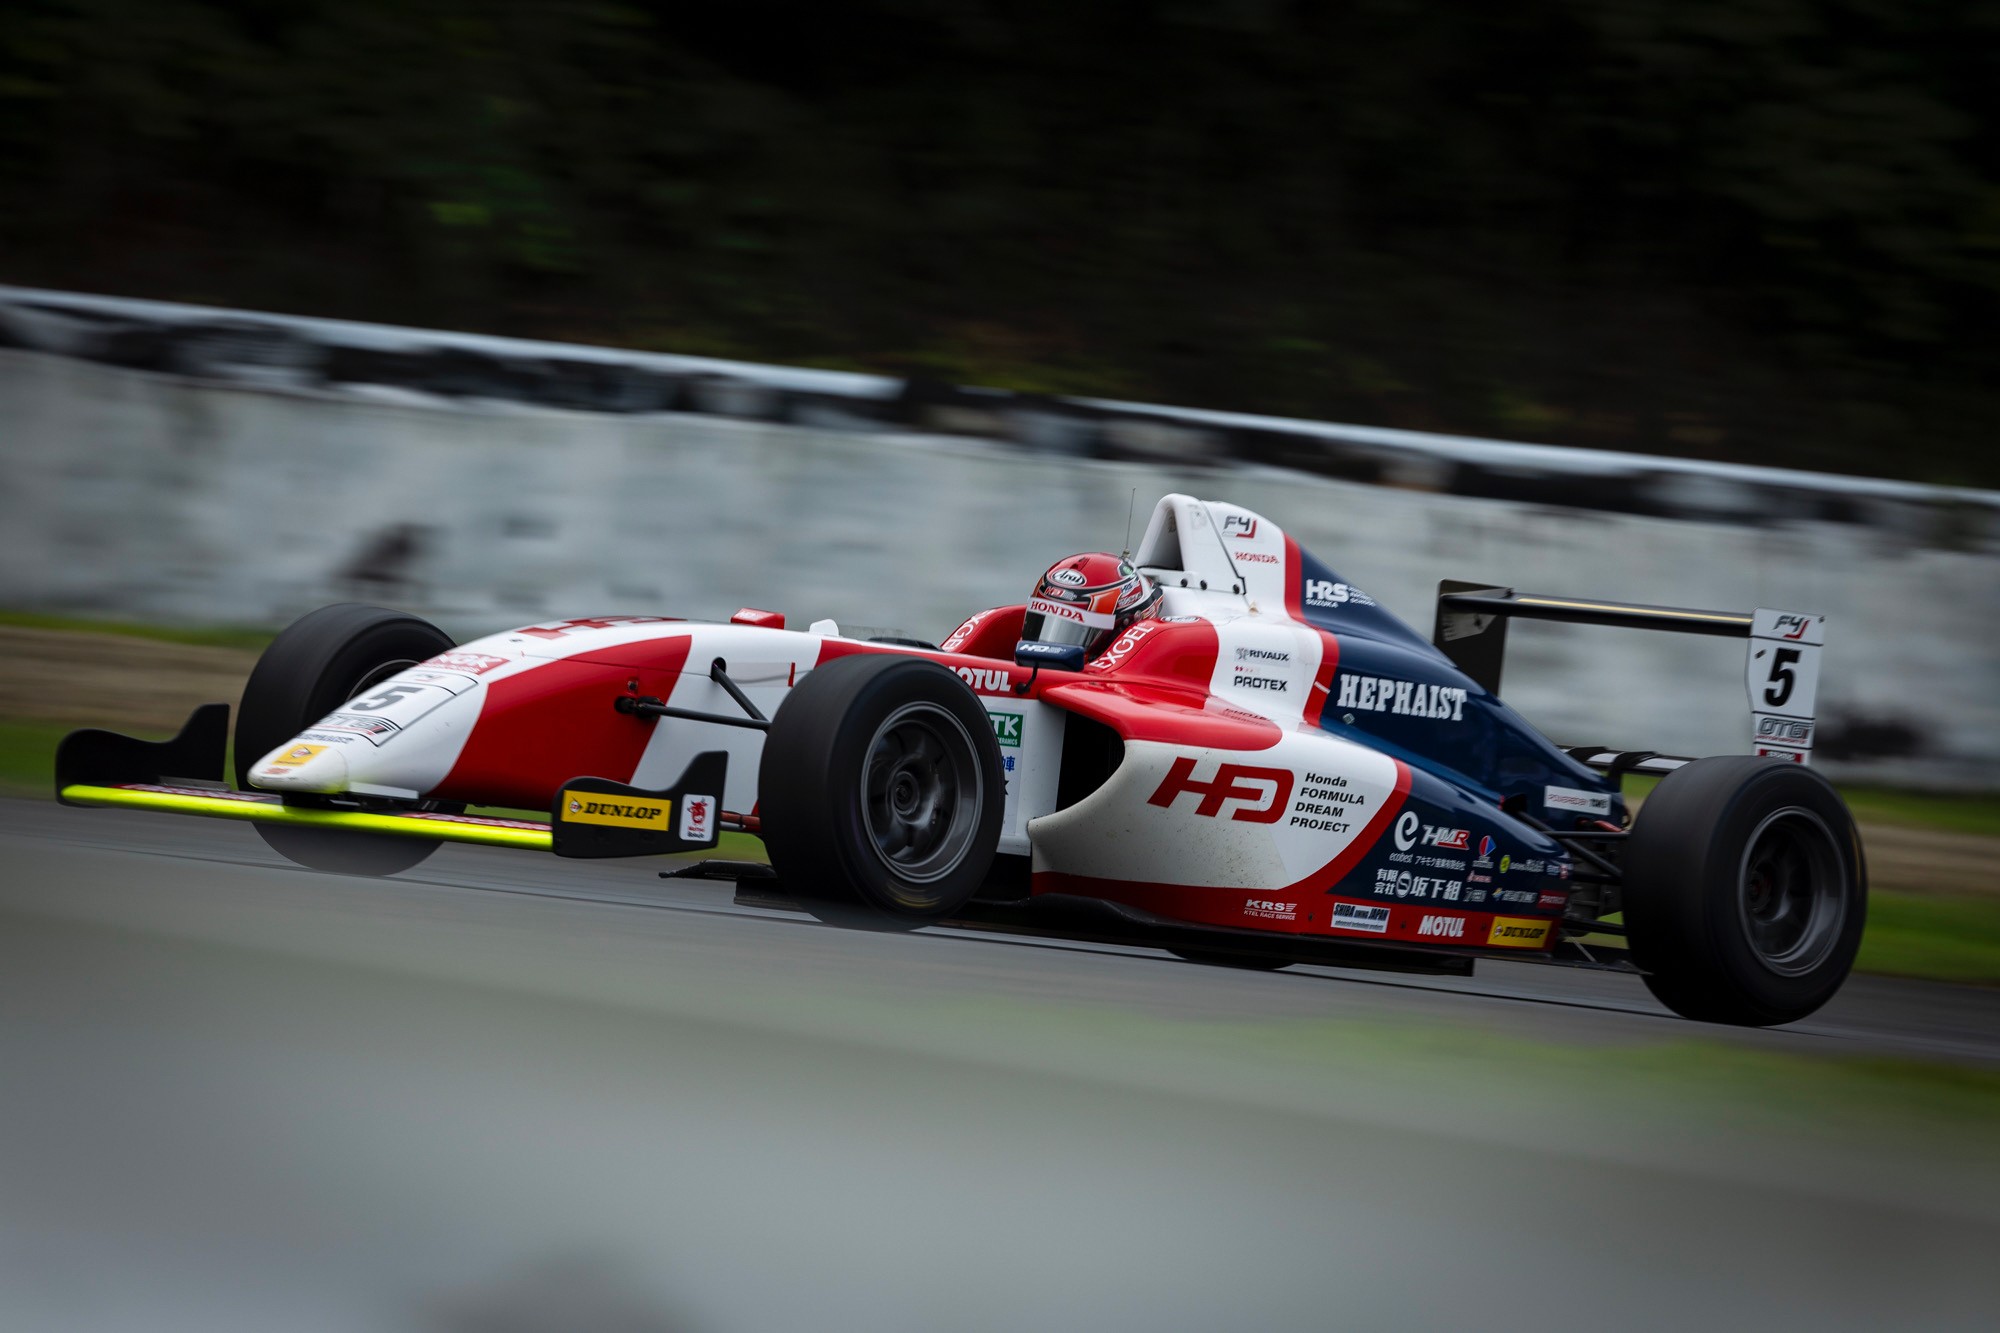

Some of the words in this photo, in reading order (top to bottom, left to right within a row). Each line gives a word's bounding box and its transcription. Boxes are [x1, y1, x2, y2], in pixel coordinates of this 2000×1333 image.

[1235, 552, 1279, 564] HONDA
[1057, 570, 1082, 583] Arai
[1305, 578, 1350, 603] HRS
[1030, 601, 1084, 623] HONDA
[1305, 598, 1339, 608] SUZUKA
[1089, 624, 1155, 669] EXGEL
[1249, 649, 1289, 662] RIVAUX
[1234, 675, 1288, 692] PROTEX
[1764, 648, 1802, 707] 5
[349, 685, 425, 711] 5
[1337, 673, 1467, 721] HEPHAIST
[989, 713, 1019, 737] TK
[1305, 772, 1348, 788] Honda
[1300, 787, 1365, 806] FORMULA
[583, 801, 662, 820] DUNLOP
[1295, 802, 1344, 818] DREAM
[1290, 816, 1350, 834] PROJECT
[1409, 876, 1462, 900] 坂下組
[1246, 899, 1286, 911] KRS
[1417, 915, 1466, 938] MOTUL
[1502, 926, 1546, 939] DUNLOP
